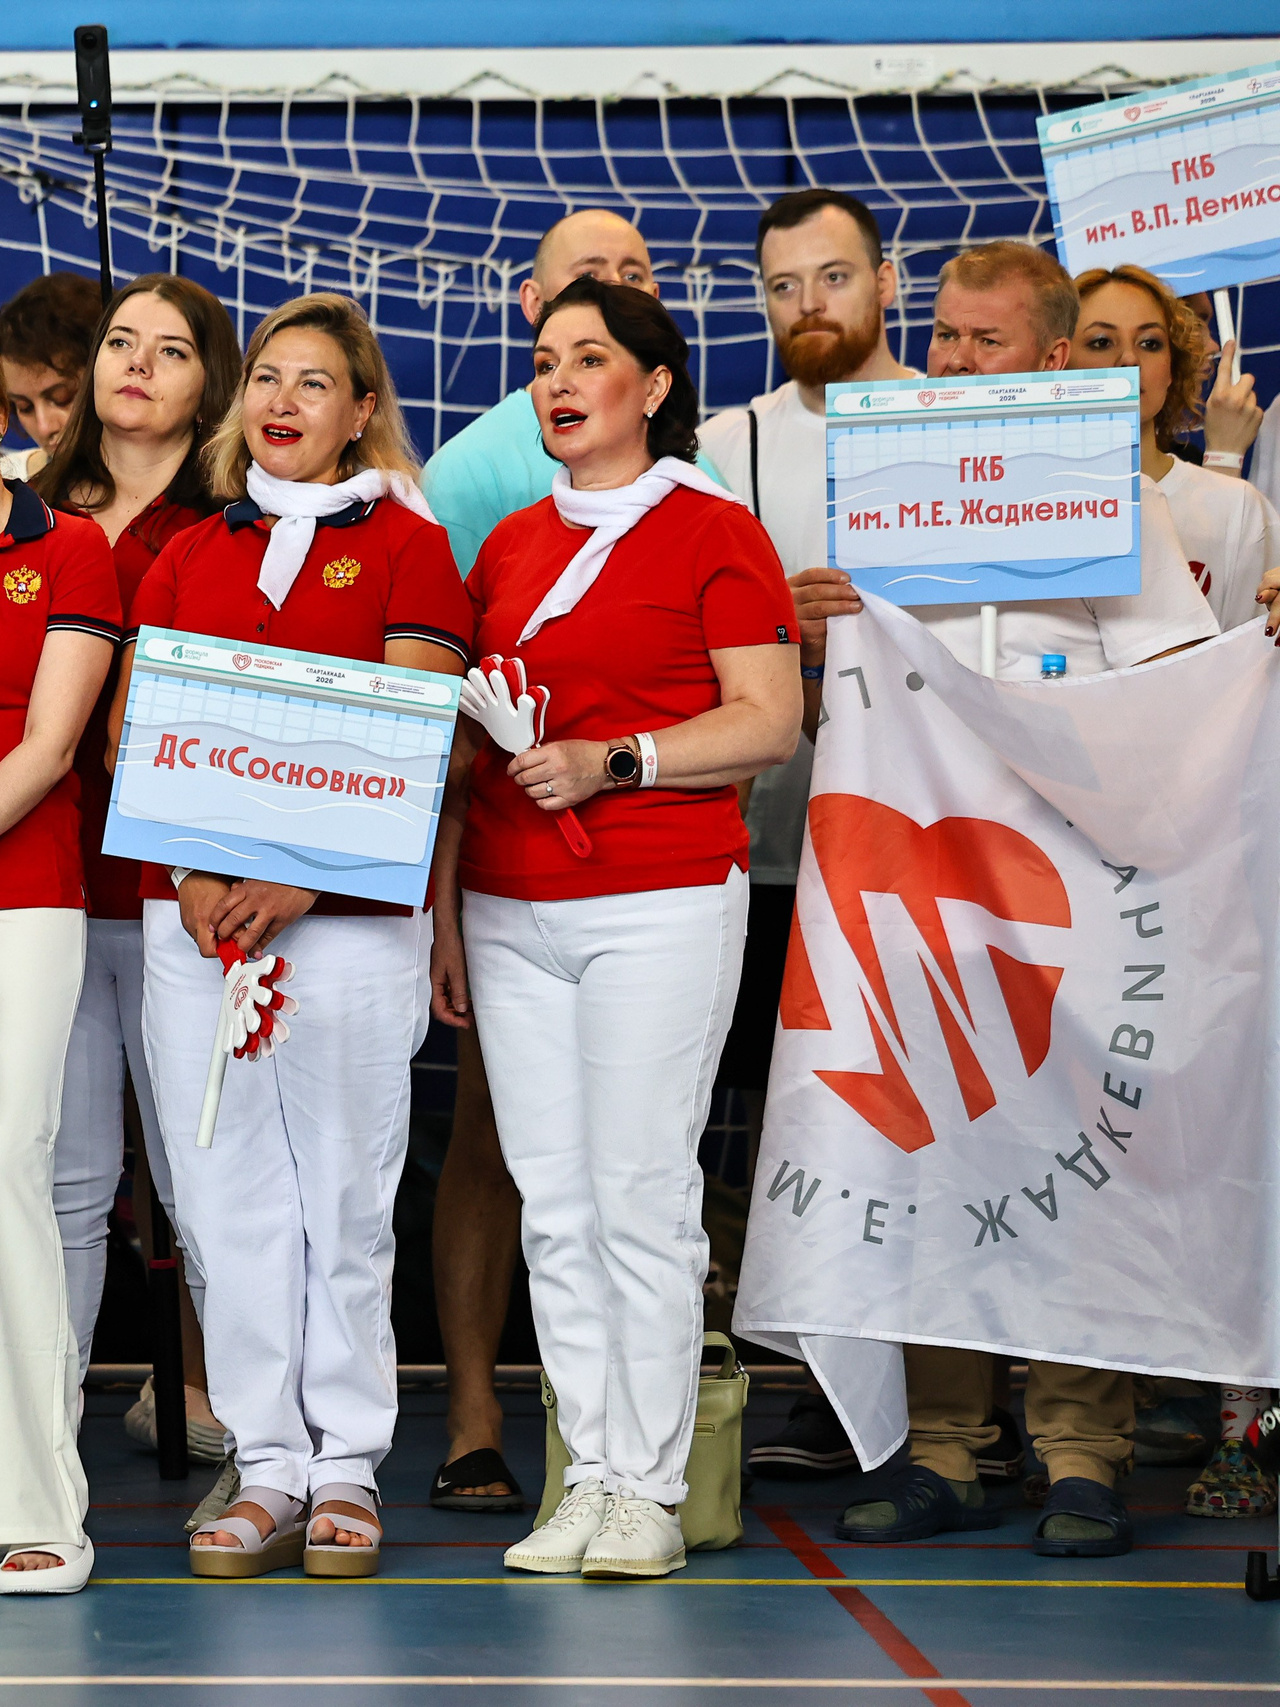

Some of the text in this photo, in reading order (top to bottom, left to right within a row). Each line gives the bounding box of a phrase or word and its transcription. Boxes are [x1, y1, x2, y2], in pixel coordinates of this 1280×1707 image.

[1171, 153, 1216, 185] ГКБ
[1086, 183, 1280, 246] им. В.П. Демихо
[959, 455, 1005, 483] ГКБ
[848, 498, 1119, 532] им. М.Е. Жадкевича
[315, 676, 334, 685] 2026
[153, 733, 407, 800] ДС «Сосновка»
